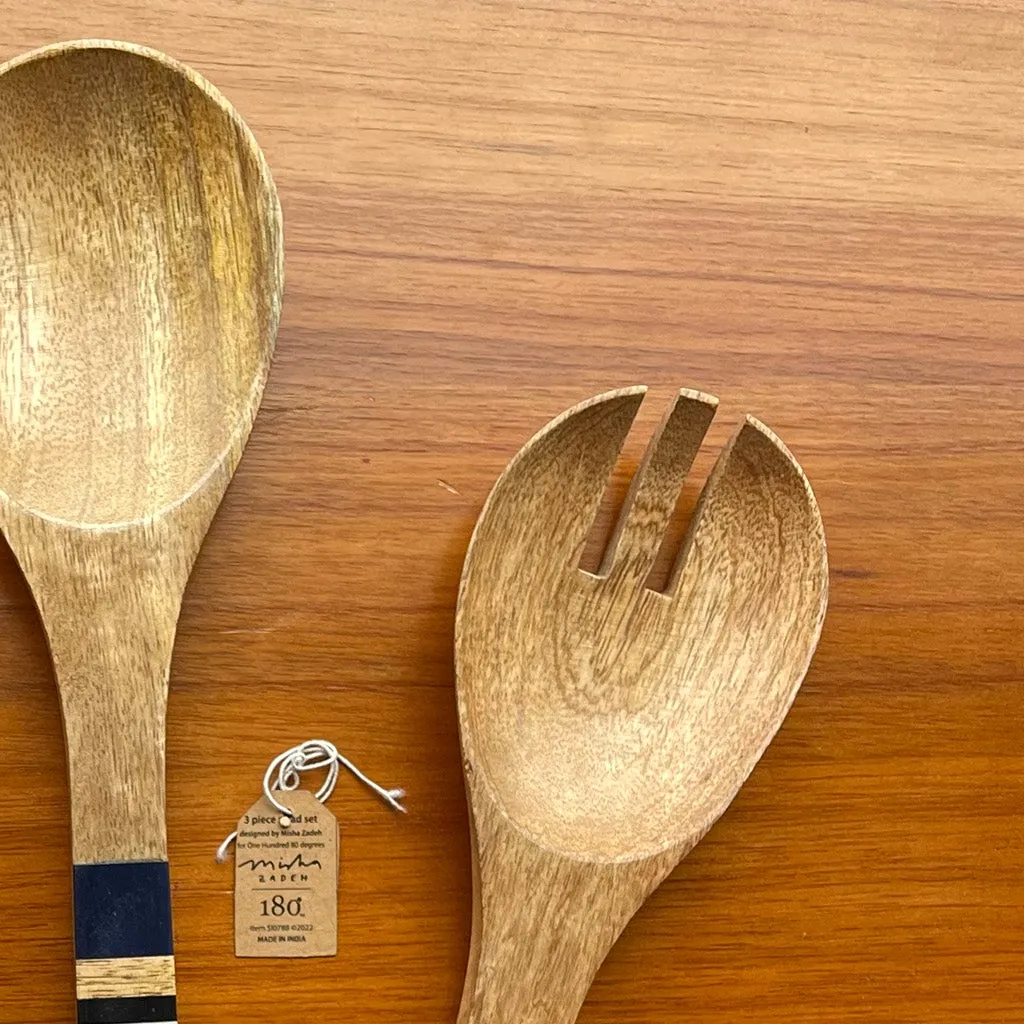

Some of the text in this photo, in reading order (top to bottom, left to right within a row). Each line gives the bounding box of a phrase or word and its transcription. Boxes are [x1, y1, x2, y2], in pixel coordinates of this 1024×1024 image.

[244, 816, 250, 824] 3
[252, 816, 276, 825] piece
[259, 874, 308, 882] ZADEH
